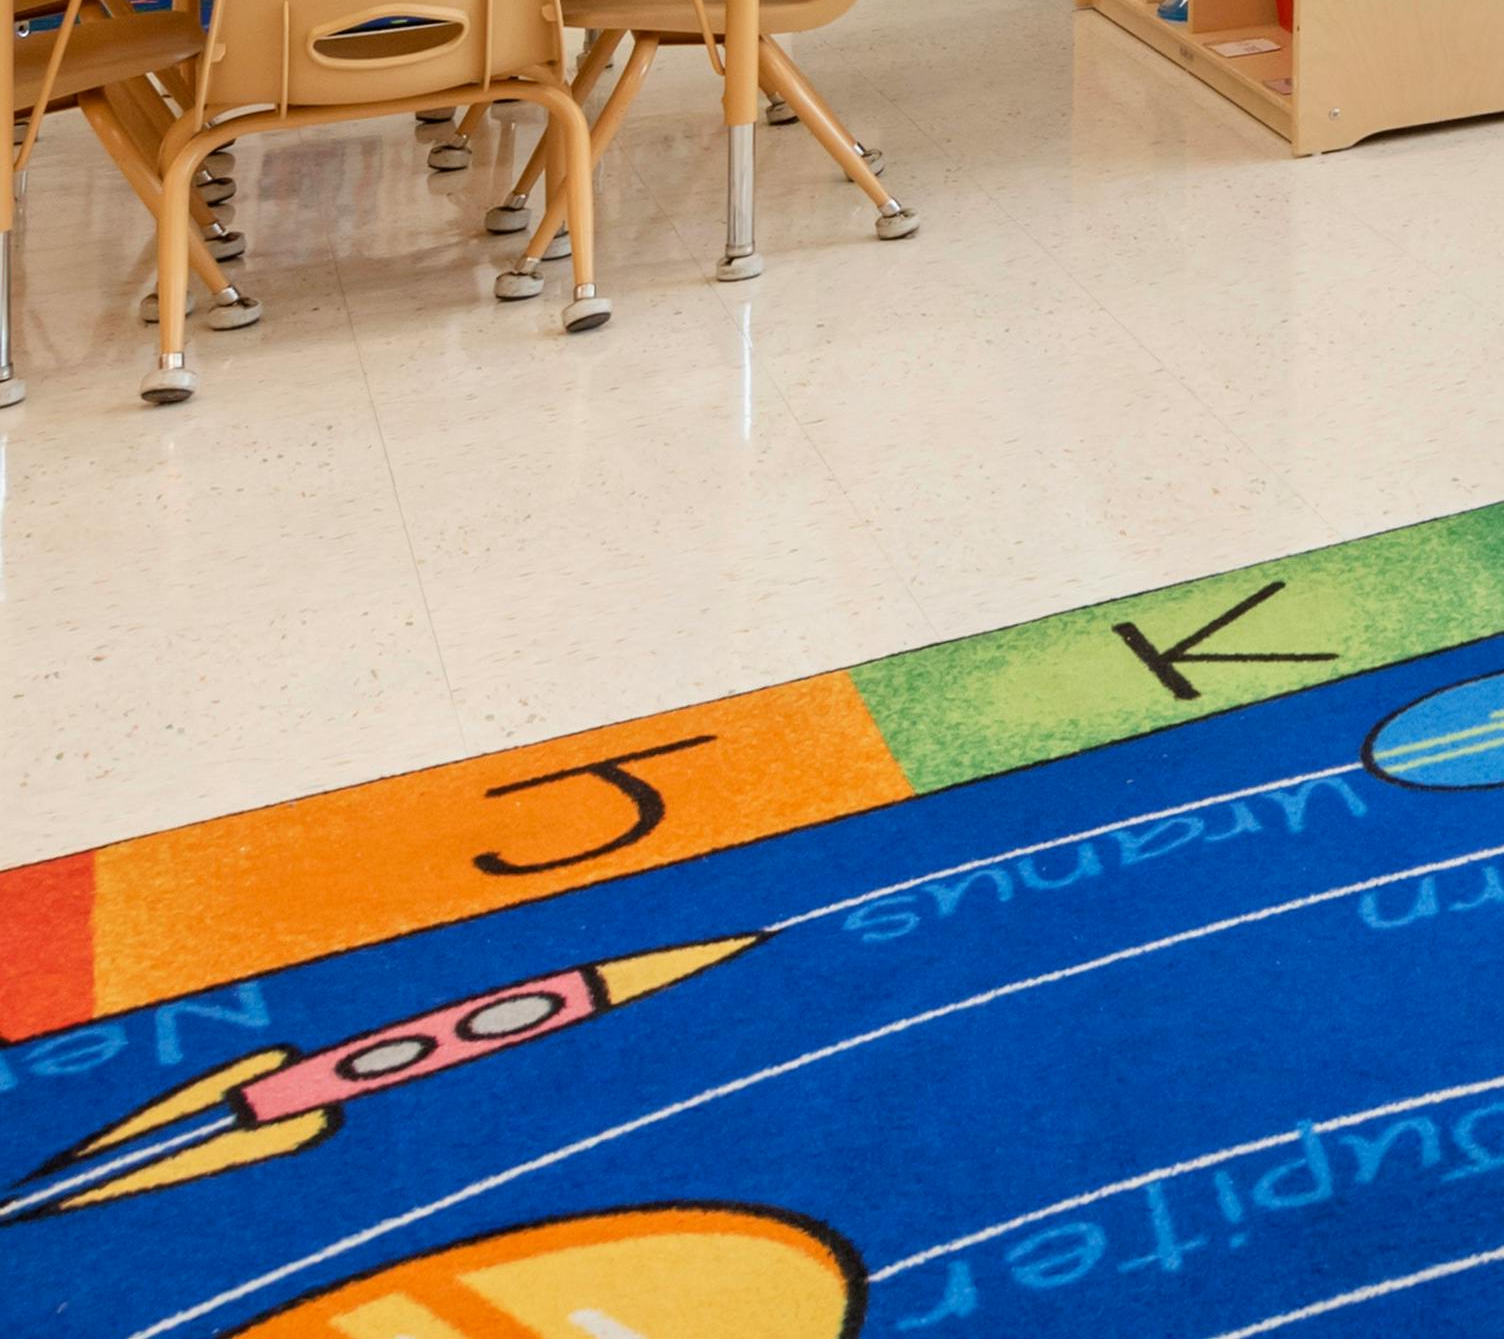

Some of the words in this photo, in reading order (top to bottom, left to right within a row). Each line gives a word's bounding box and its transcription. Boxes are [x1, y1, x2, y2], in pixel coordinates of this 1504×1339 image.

[1110, 583, 1341, 703] K
[472, 736, 722, 881] J
[844, 779, 1373, 945] Uranus
